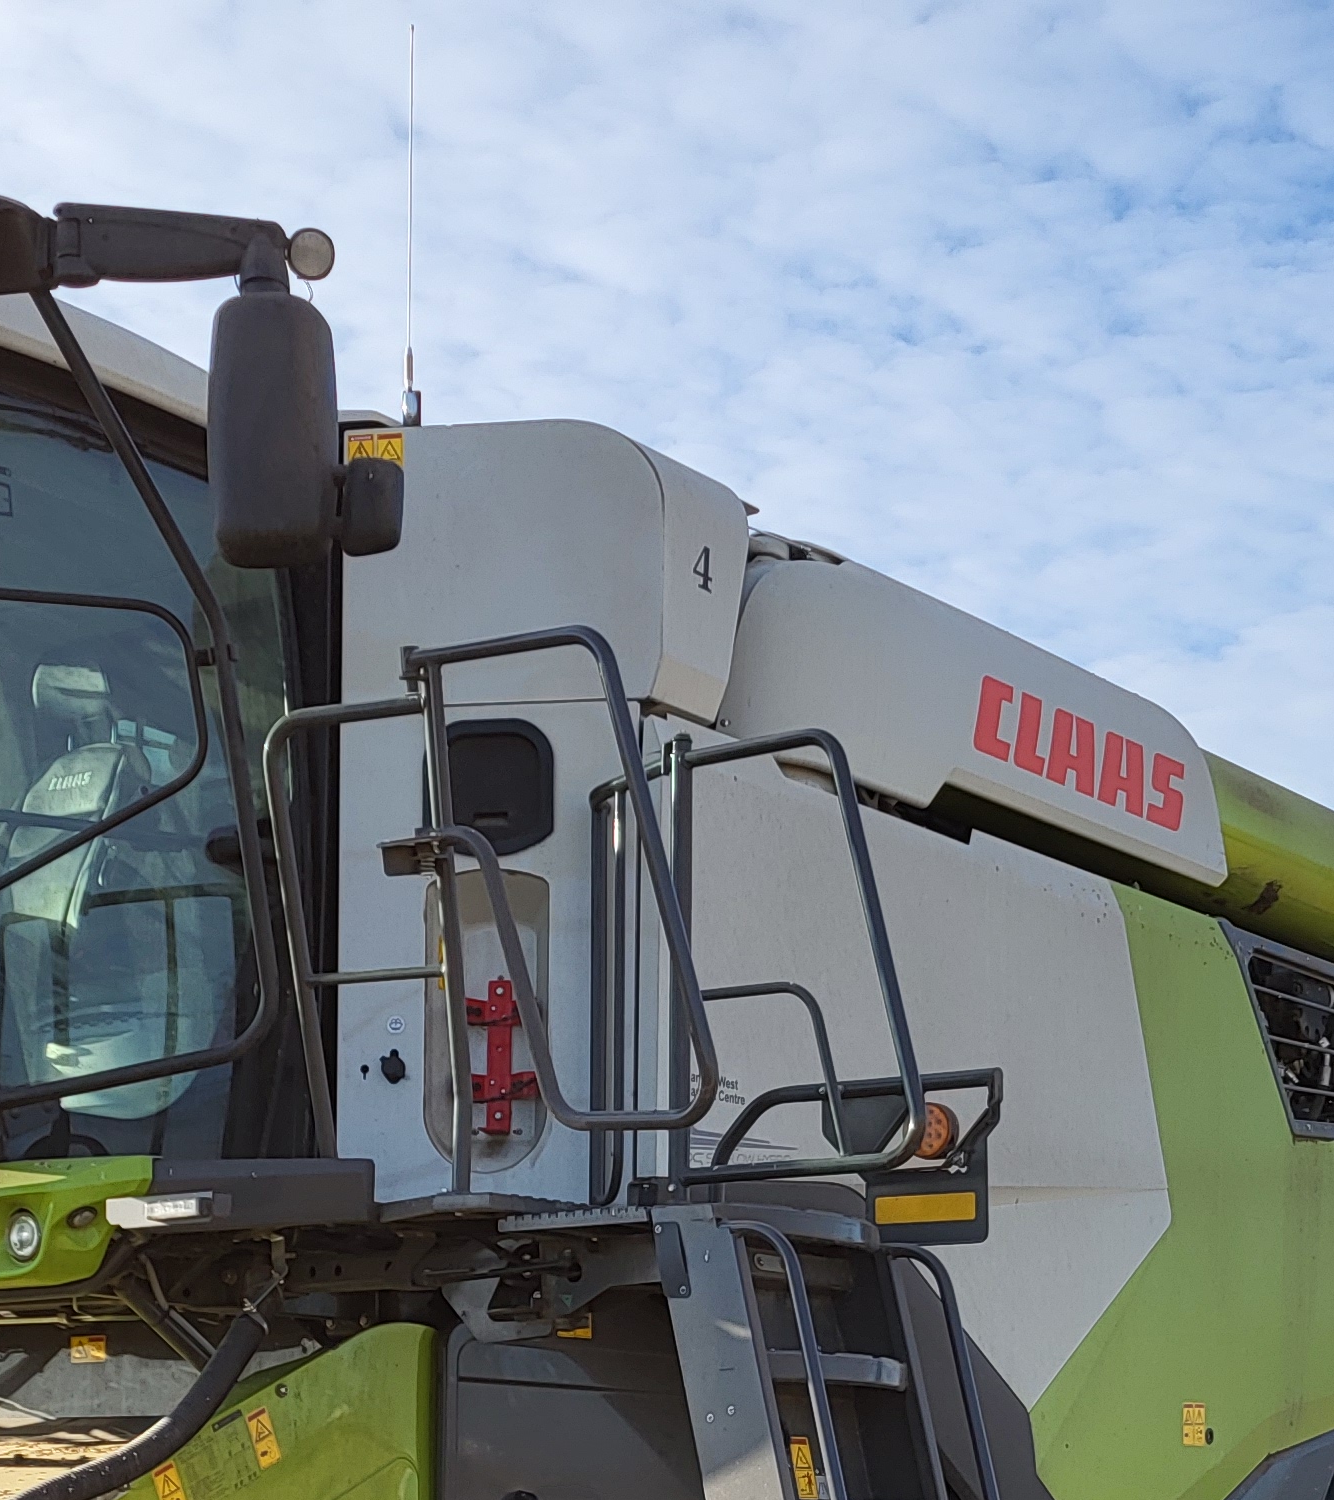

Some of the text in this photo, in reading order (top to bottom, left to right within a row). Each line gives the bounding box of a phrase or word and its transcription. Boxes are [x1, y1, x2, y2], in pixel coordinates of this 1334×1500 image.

[692, 545, 713, 595] 4
[973, 674, 1185, 832] CLAAS
[718, 1076, 739, 1091] West
[718, 1090, 746, 1106] Centre
